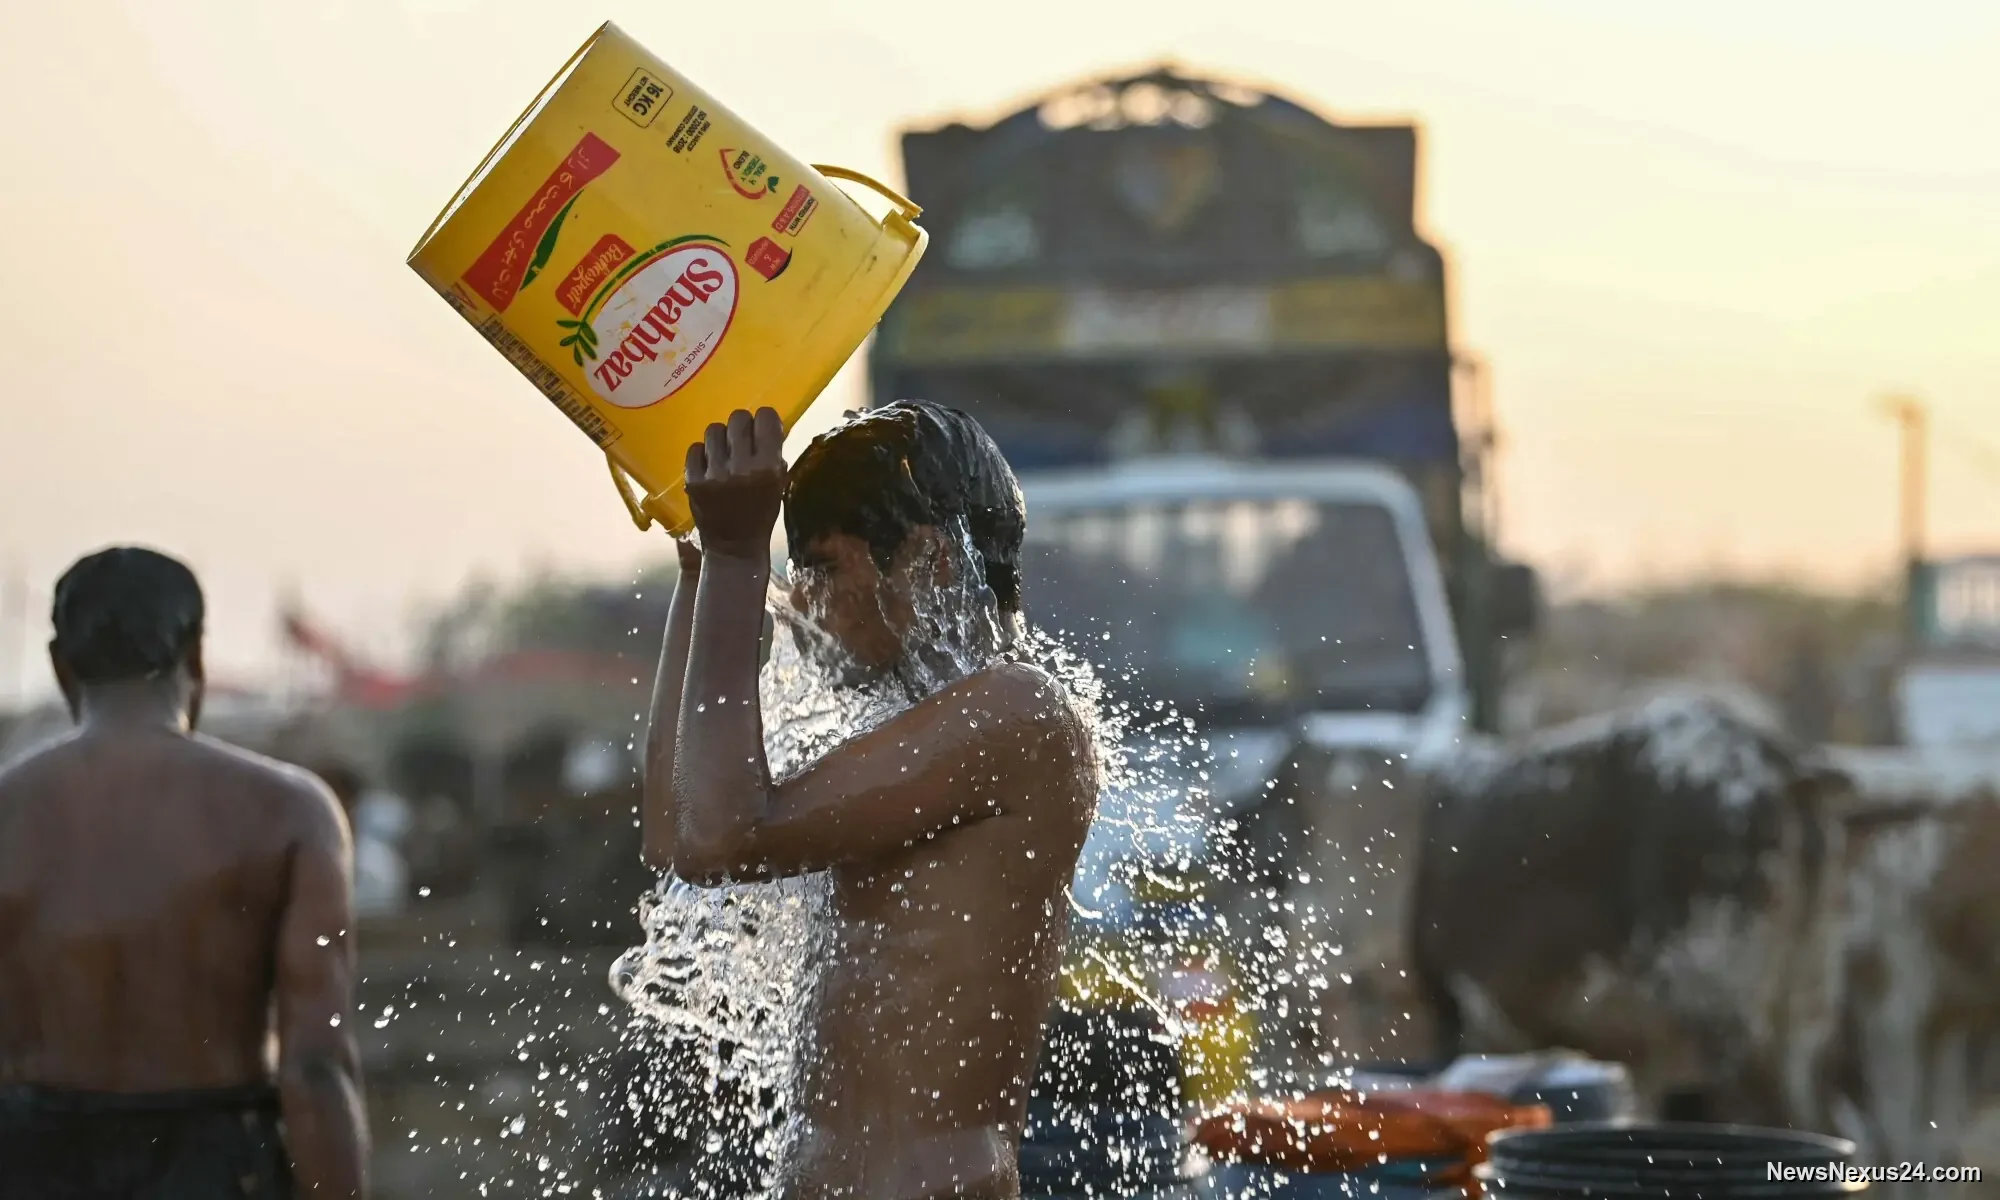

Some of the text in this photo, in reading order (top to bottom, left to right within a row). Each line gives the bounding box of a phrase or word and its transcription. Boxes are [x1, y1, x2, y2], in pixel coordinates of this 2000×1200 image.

[622, 83, 642, 107] WEIGHT
[631, 81, 664, 117] 16 KG
[664, 122, 686, 148] COMPANY
[731, 149, 750, 170] BLEND
[523, 183, 560, 229] صحت
[593, 255, 727, 391] Shahbaz
[670, 340, 706, 380] SINCE 1983
